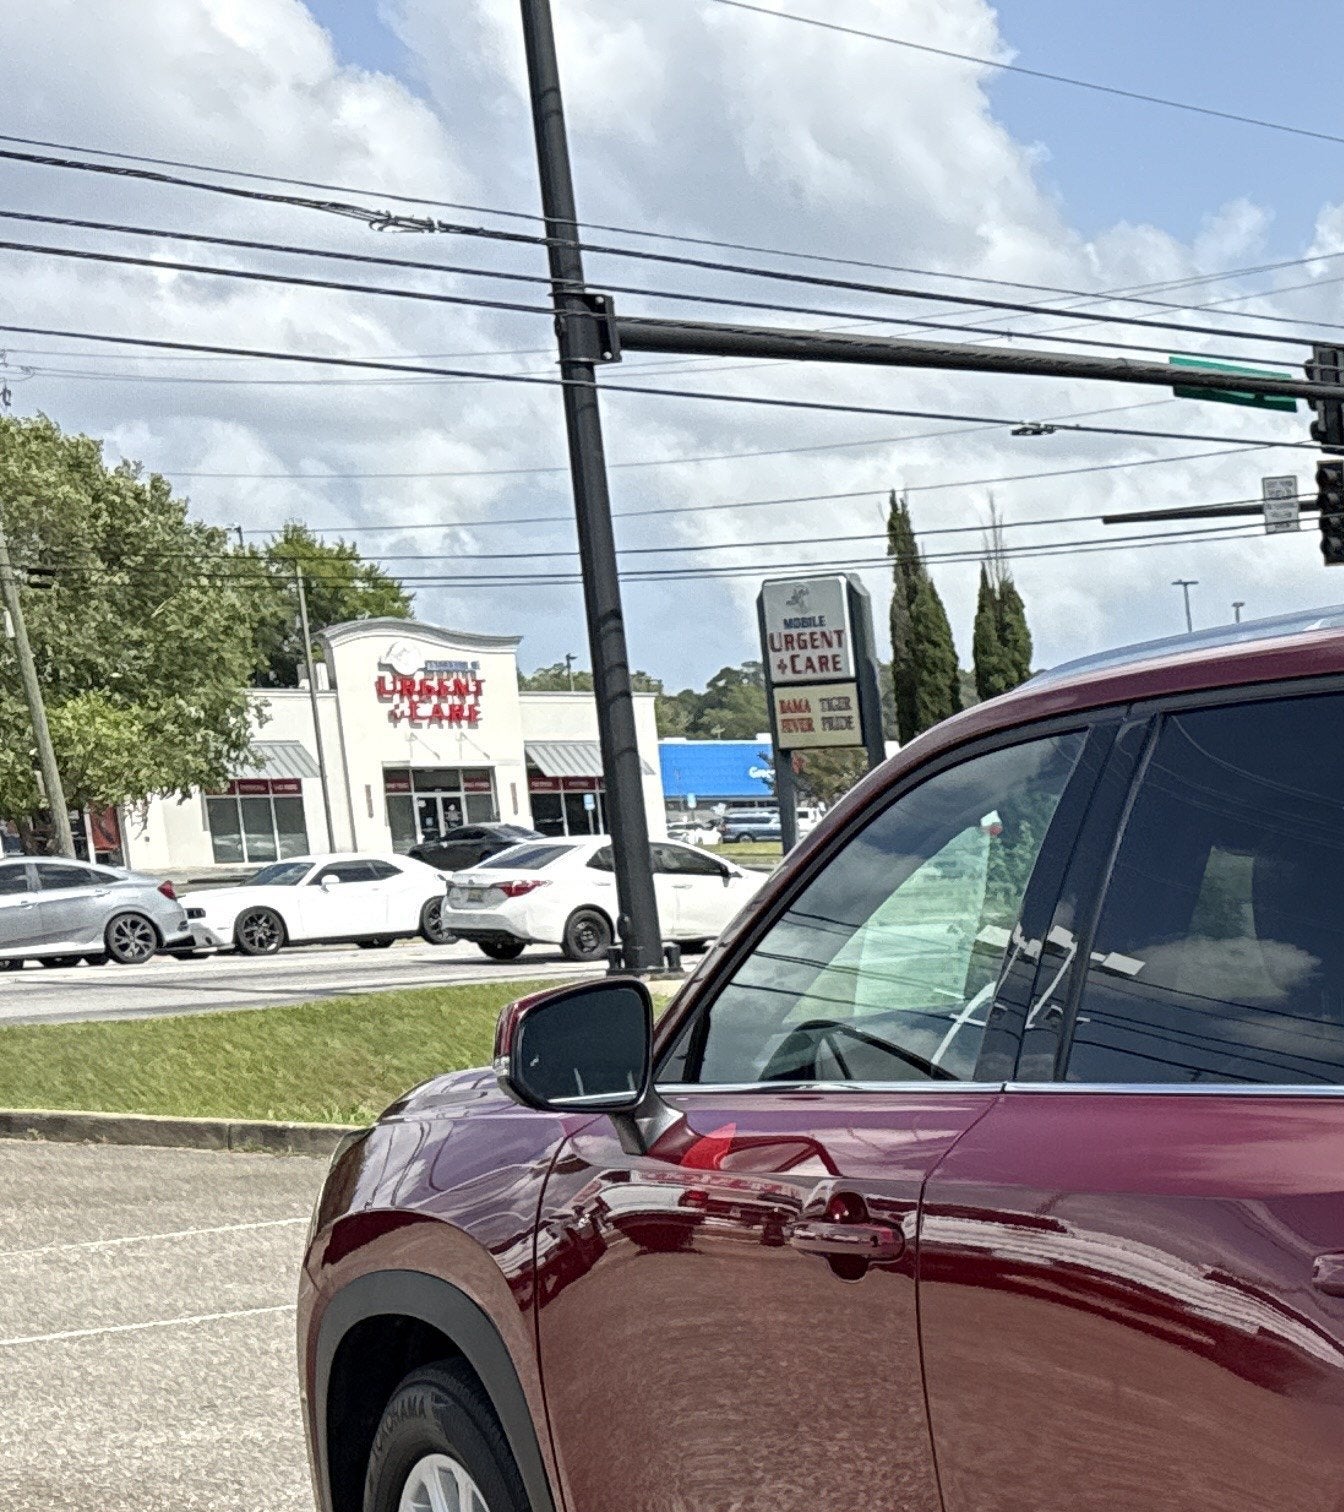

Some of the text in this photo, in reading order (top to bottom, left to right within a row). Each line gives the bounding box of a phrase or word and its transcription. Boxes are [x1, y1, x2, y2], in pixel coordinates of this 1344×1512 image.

[783, 614, 826, 629] MOBILE
[768, 629, 844, 653] URGENT
[375, 675, 486, 699] URGENT
